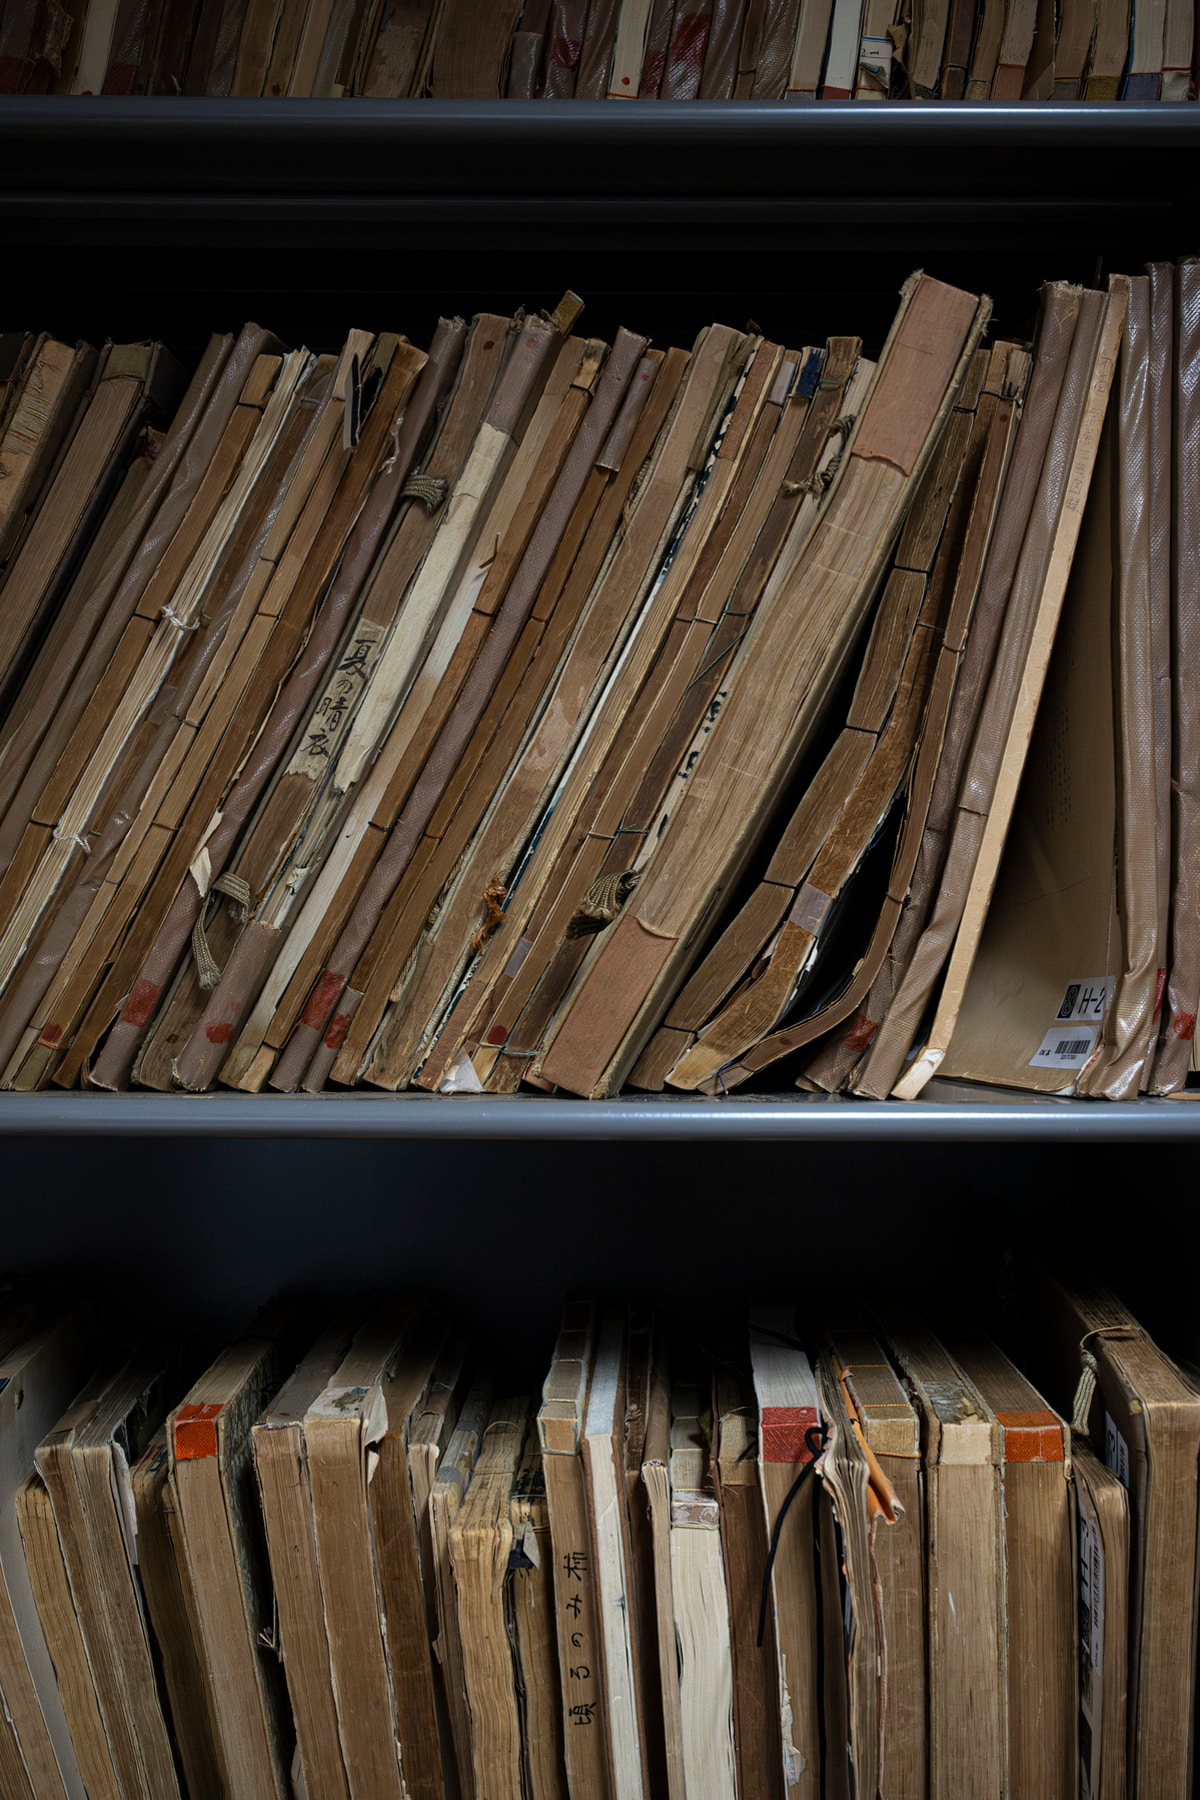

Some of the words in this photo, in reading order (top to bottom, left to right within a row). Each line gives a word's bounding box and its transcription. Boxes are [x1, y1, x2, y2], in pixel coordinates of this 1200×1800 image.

[300, 639, 378, 758] 夏の晴衣
[1078, 986, 1107, 1015] H-2
